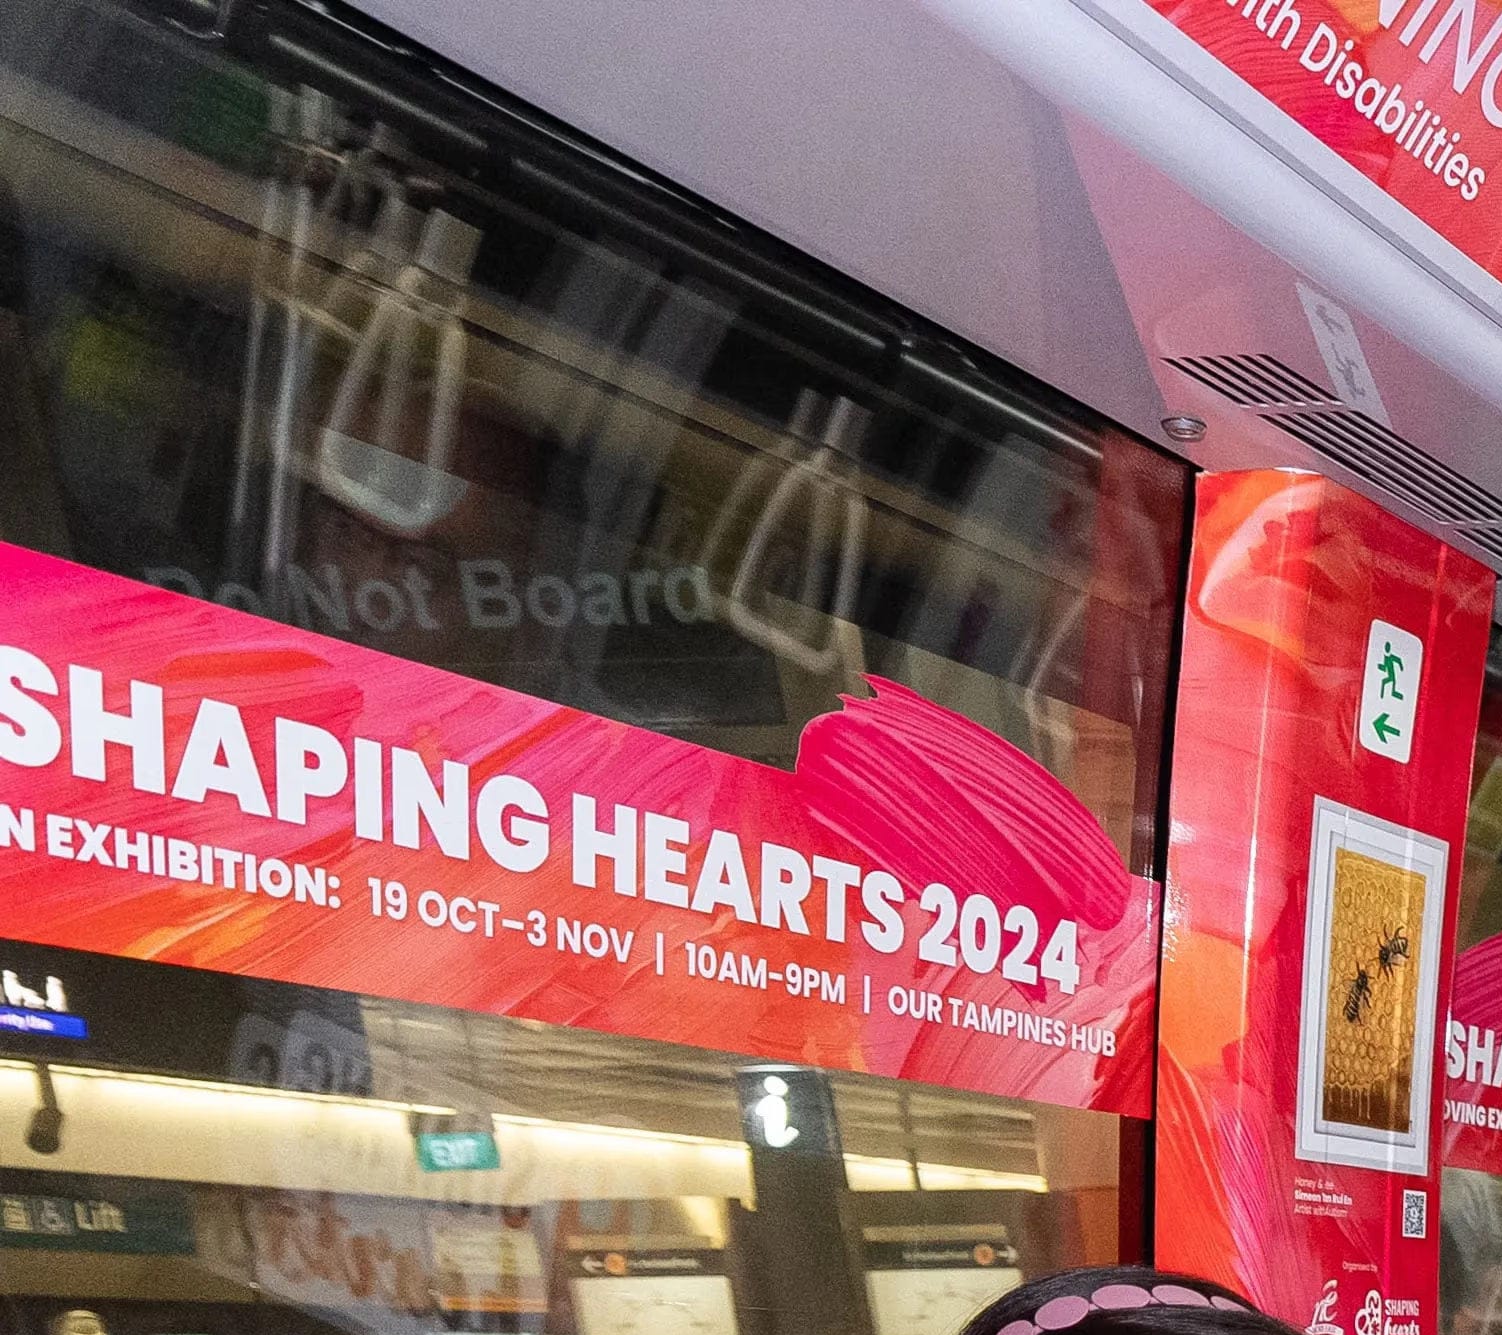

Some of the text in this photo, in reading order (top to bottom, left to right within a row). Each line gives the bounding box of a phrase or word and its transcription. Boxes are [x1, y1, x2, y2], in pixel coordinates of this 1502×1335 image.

[1299, 22, 1486, 201] Disabilities
[465, 556, 717, 630] Board
[0, 644, 1082, 996] SHAPING HEARTS 2024
[46, 813, 343, 908] EXHIBITION:
[367, 876, 408, 921] 19
[556, 917, 635, 963] NOV
[684, 940, 847, 1005] 10AM-9PM
[887, 985, 944, 1023] OUR
[948, 996, 1066, 1048] TAMPINES
[1070, 1019, 1119, 1058] HUB
[1384, 1299, 1420, 1317] SHAPING
